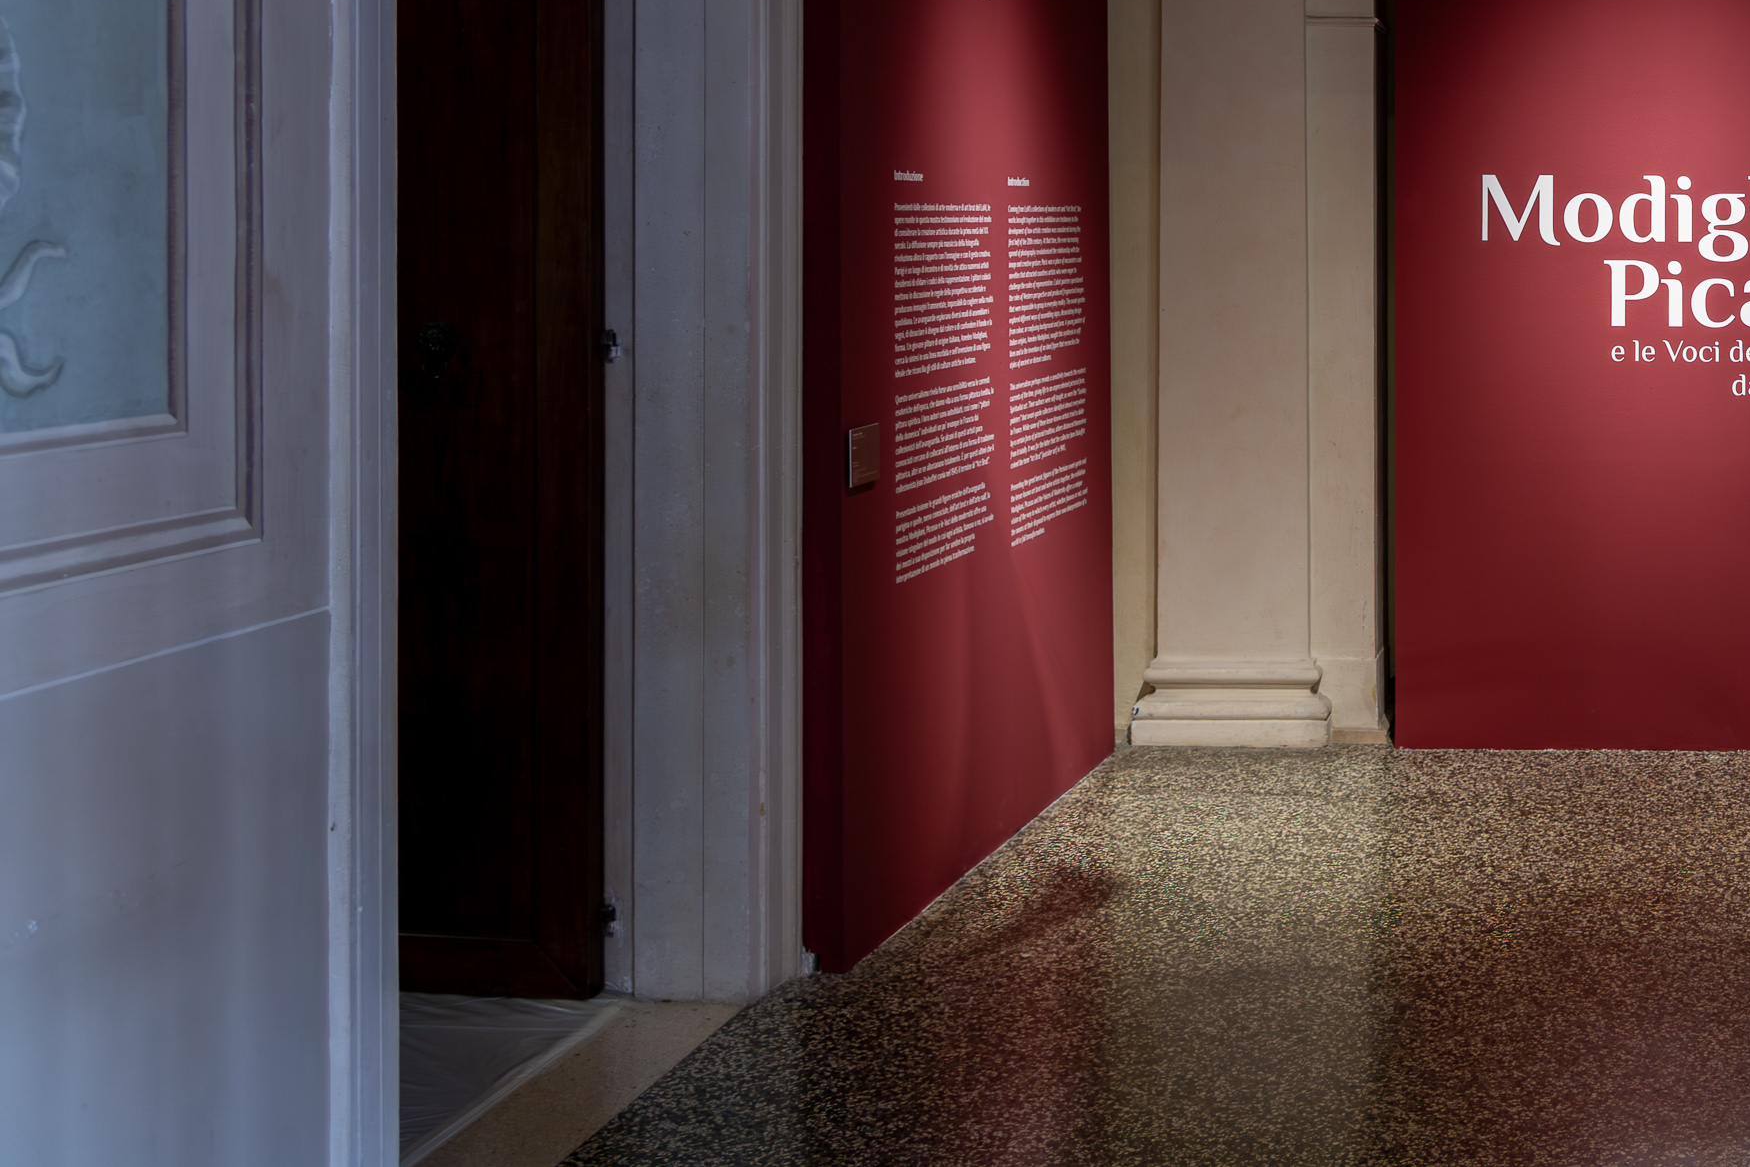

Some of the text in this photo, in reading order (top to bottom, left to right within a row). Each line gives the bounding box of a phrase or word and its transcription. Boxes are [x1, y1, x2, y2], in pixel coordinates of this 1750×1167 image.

[894, 171, 924, 181] Introduzione
[1008, 177, 1030, 186] Introduction
[1611, 344, 1625, 362] e
[1634, 340, 1655, 362] le
[1663, 340, 1719, 362] Voci
